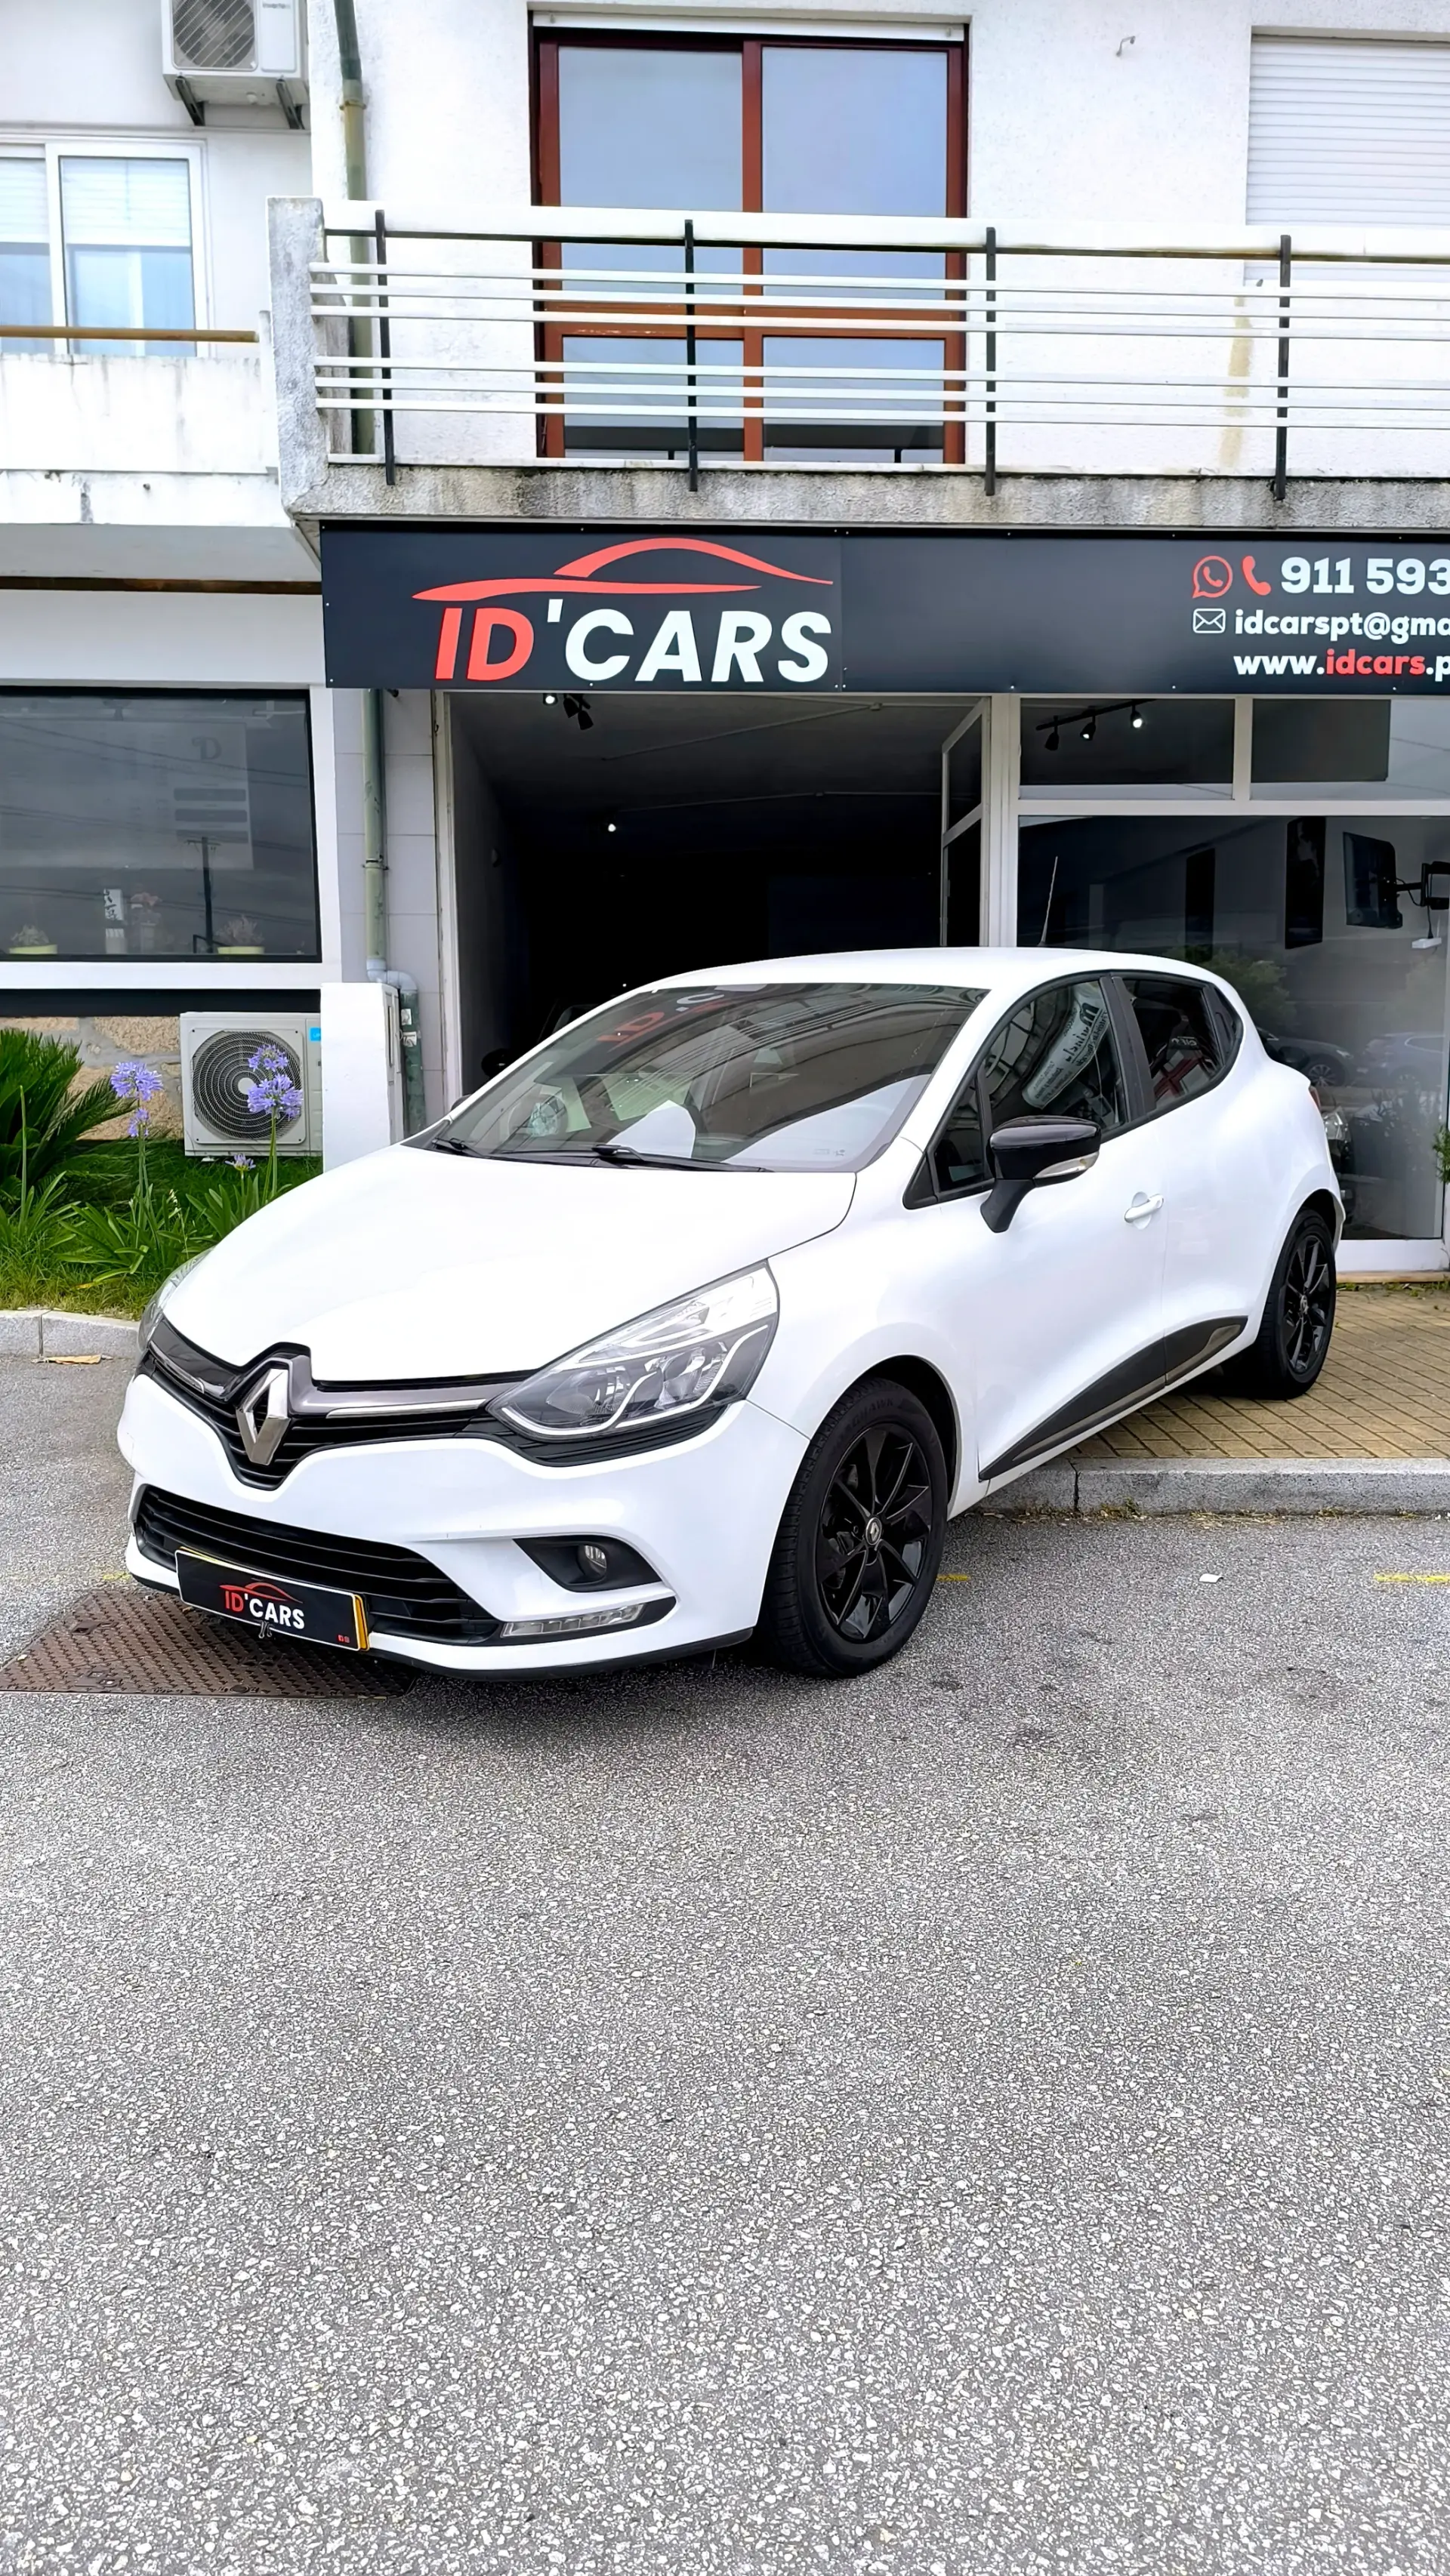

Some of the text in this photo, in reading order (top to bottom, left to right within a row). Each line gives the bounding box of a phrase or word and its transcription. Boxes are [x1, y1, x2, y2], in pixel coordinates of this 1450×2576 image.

[1281, 556, 1450, 596] 911 593
[434, 598, 832, 683] ID'CARS
[1235, 609, 1450, 645] idcarspt@gma
[1233, 648, 1450, 683] www.idcars.p
[224, 1590, 304, 1629] ID'CARS
